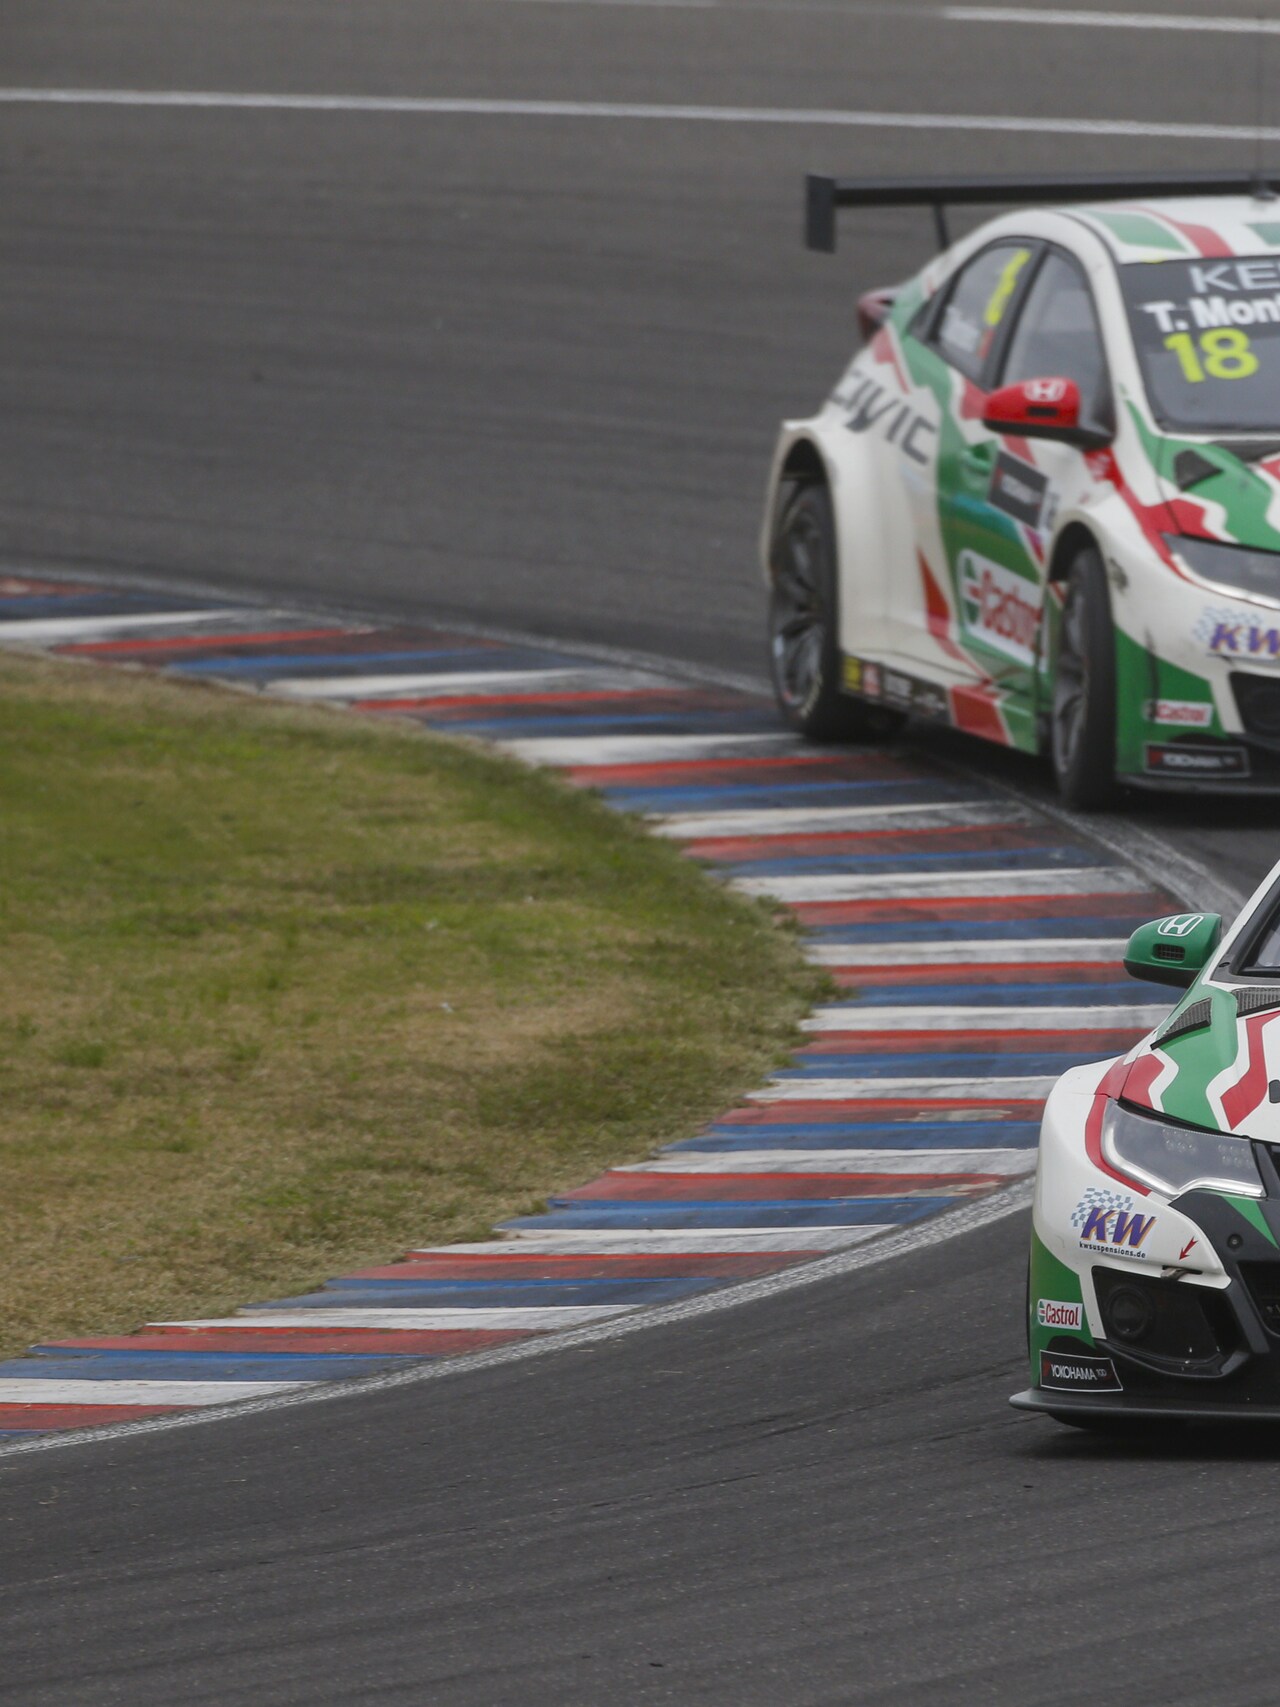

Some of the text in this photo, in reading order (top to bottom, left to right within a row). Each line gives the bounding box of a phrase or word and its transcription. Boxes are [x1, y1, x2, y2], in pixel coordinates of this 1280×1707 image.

[1144, 300, 1189, 333] T.
[1163, 327, 1260, 383] 18
[1080, 1207, 1157, 1249] KW
[1079, 1241, 1146, 1258] kwsuspensions.de
[1045, 1303, 1080, 1326] Castrol
[1050, 1364, 1098, 1381] YOKOHAMA
